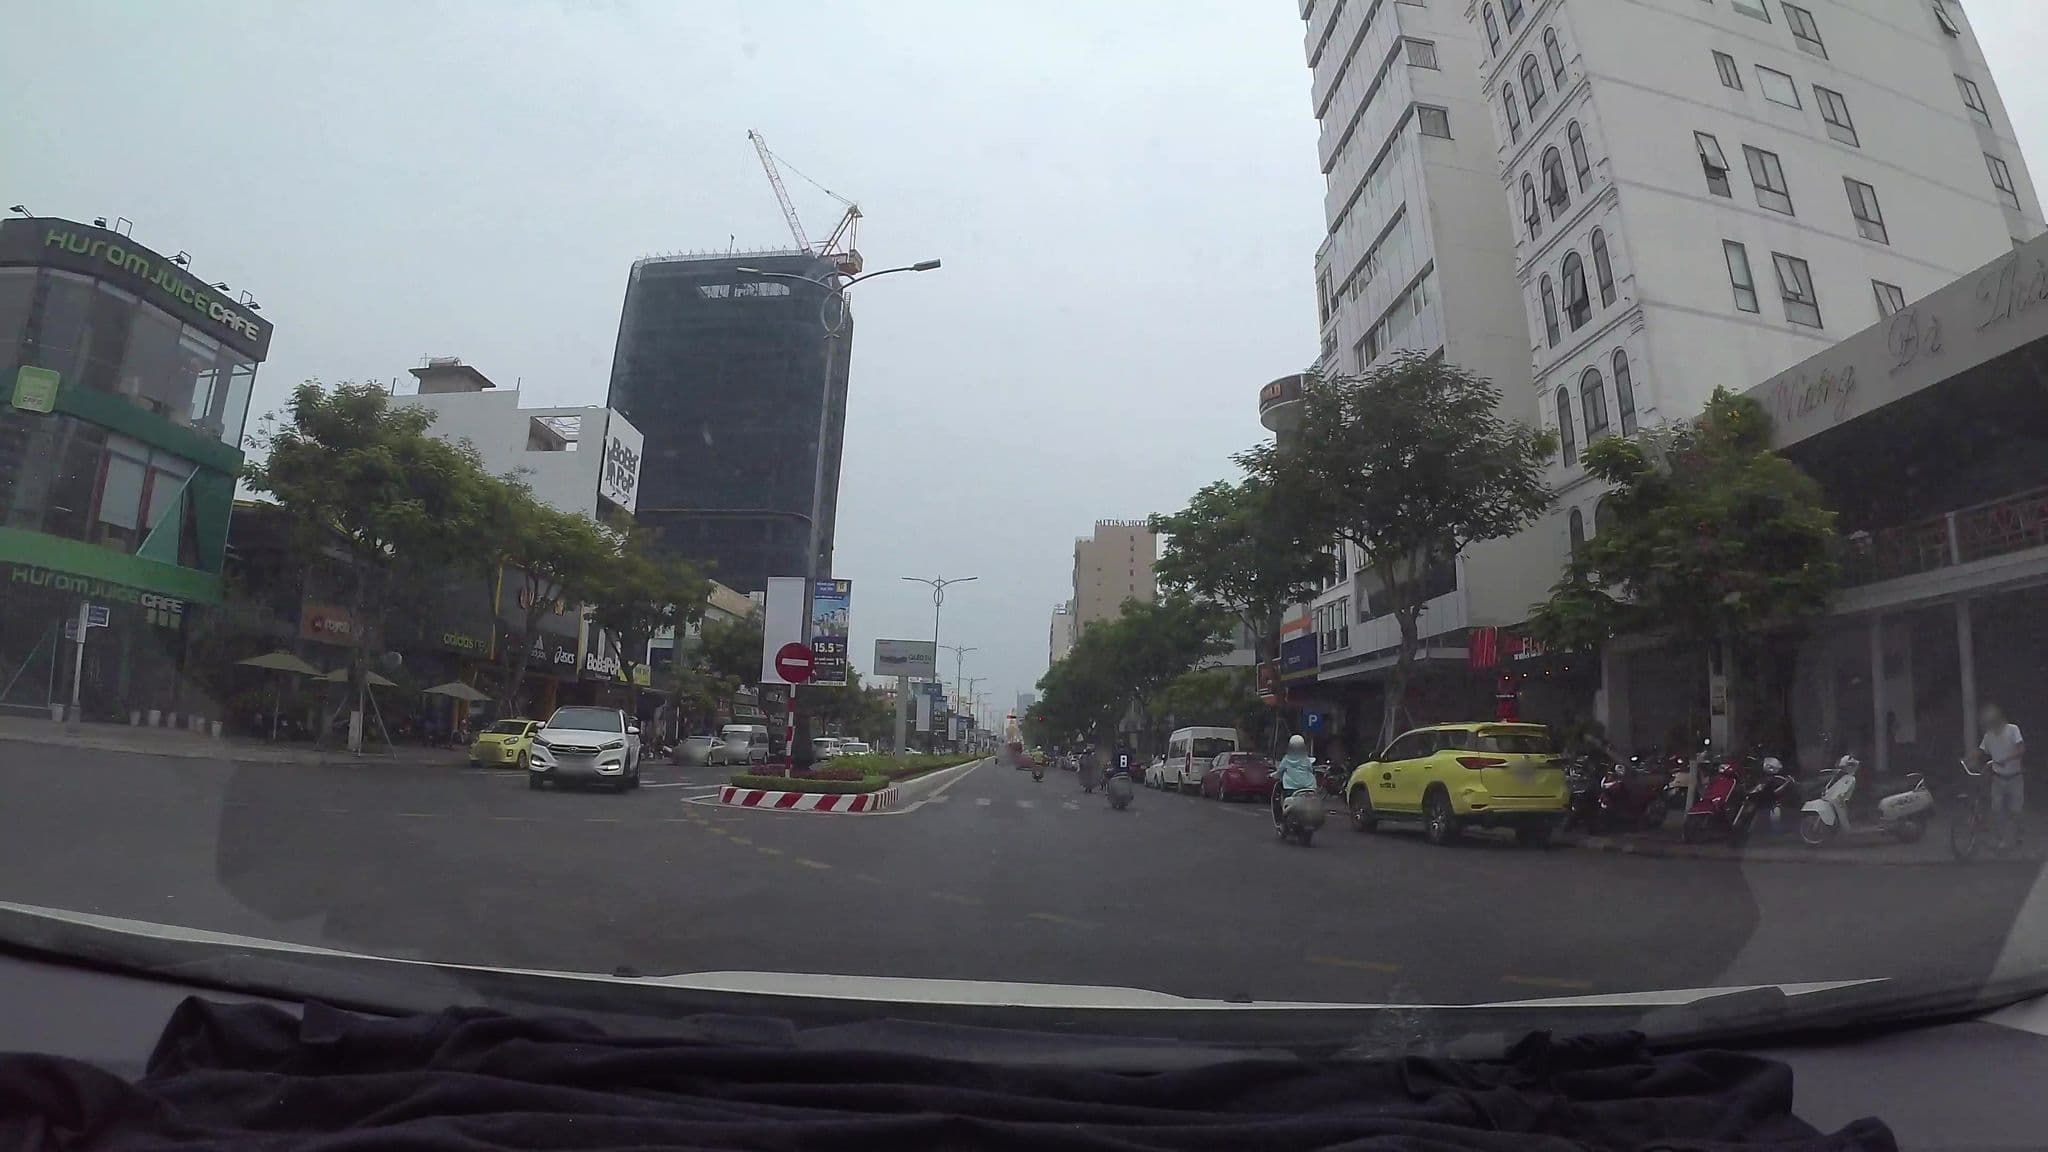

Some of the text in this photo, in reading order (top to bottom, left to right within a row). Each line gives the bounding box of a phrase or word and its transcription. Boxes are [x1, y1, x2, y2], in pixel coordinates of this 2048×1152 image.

[208, 302, 260, 342] CAFE
[141, 591, 185, 615] CAFE
[814, 642, 834, 653] 15.5
[1308, 714, 1318, 727] P
